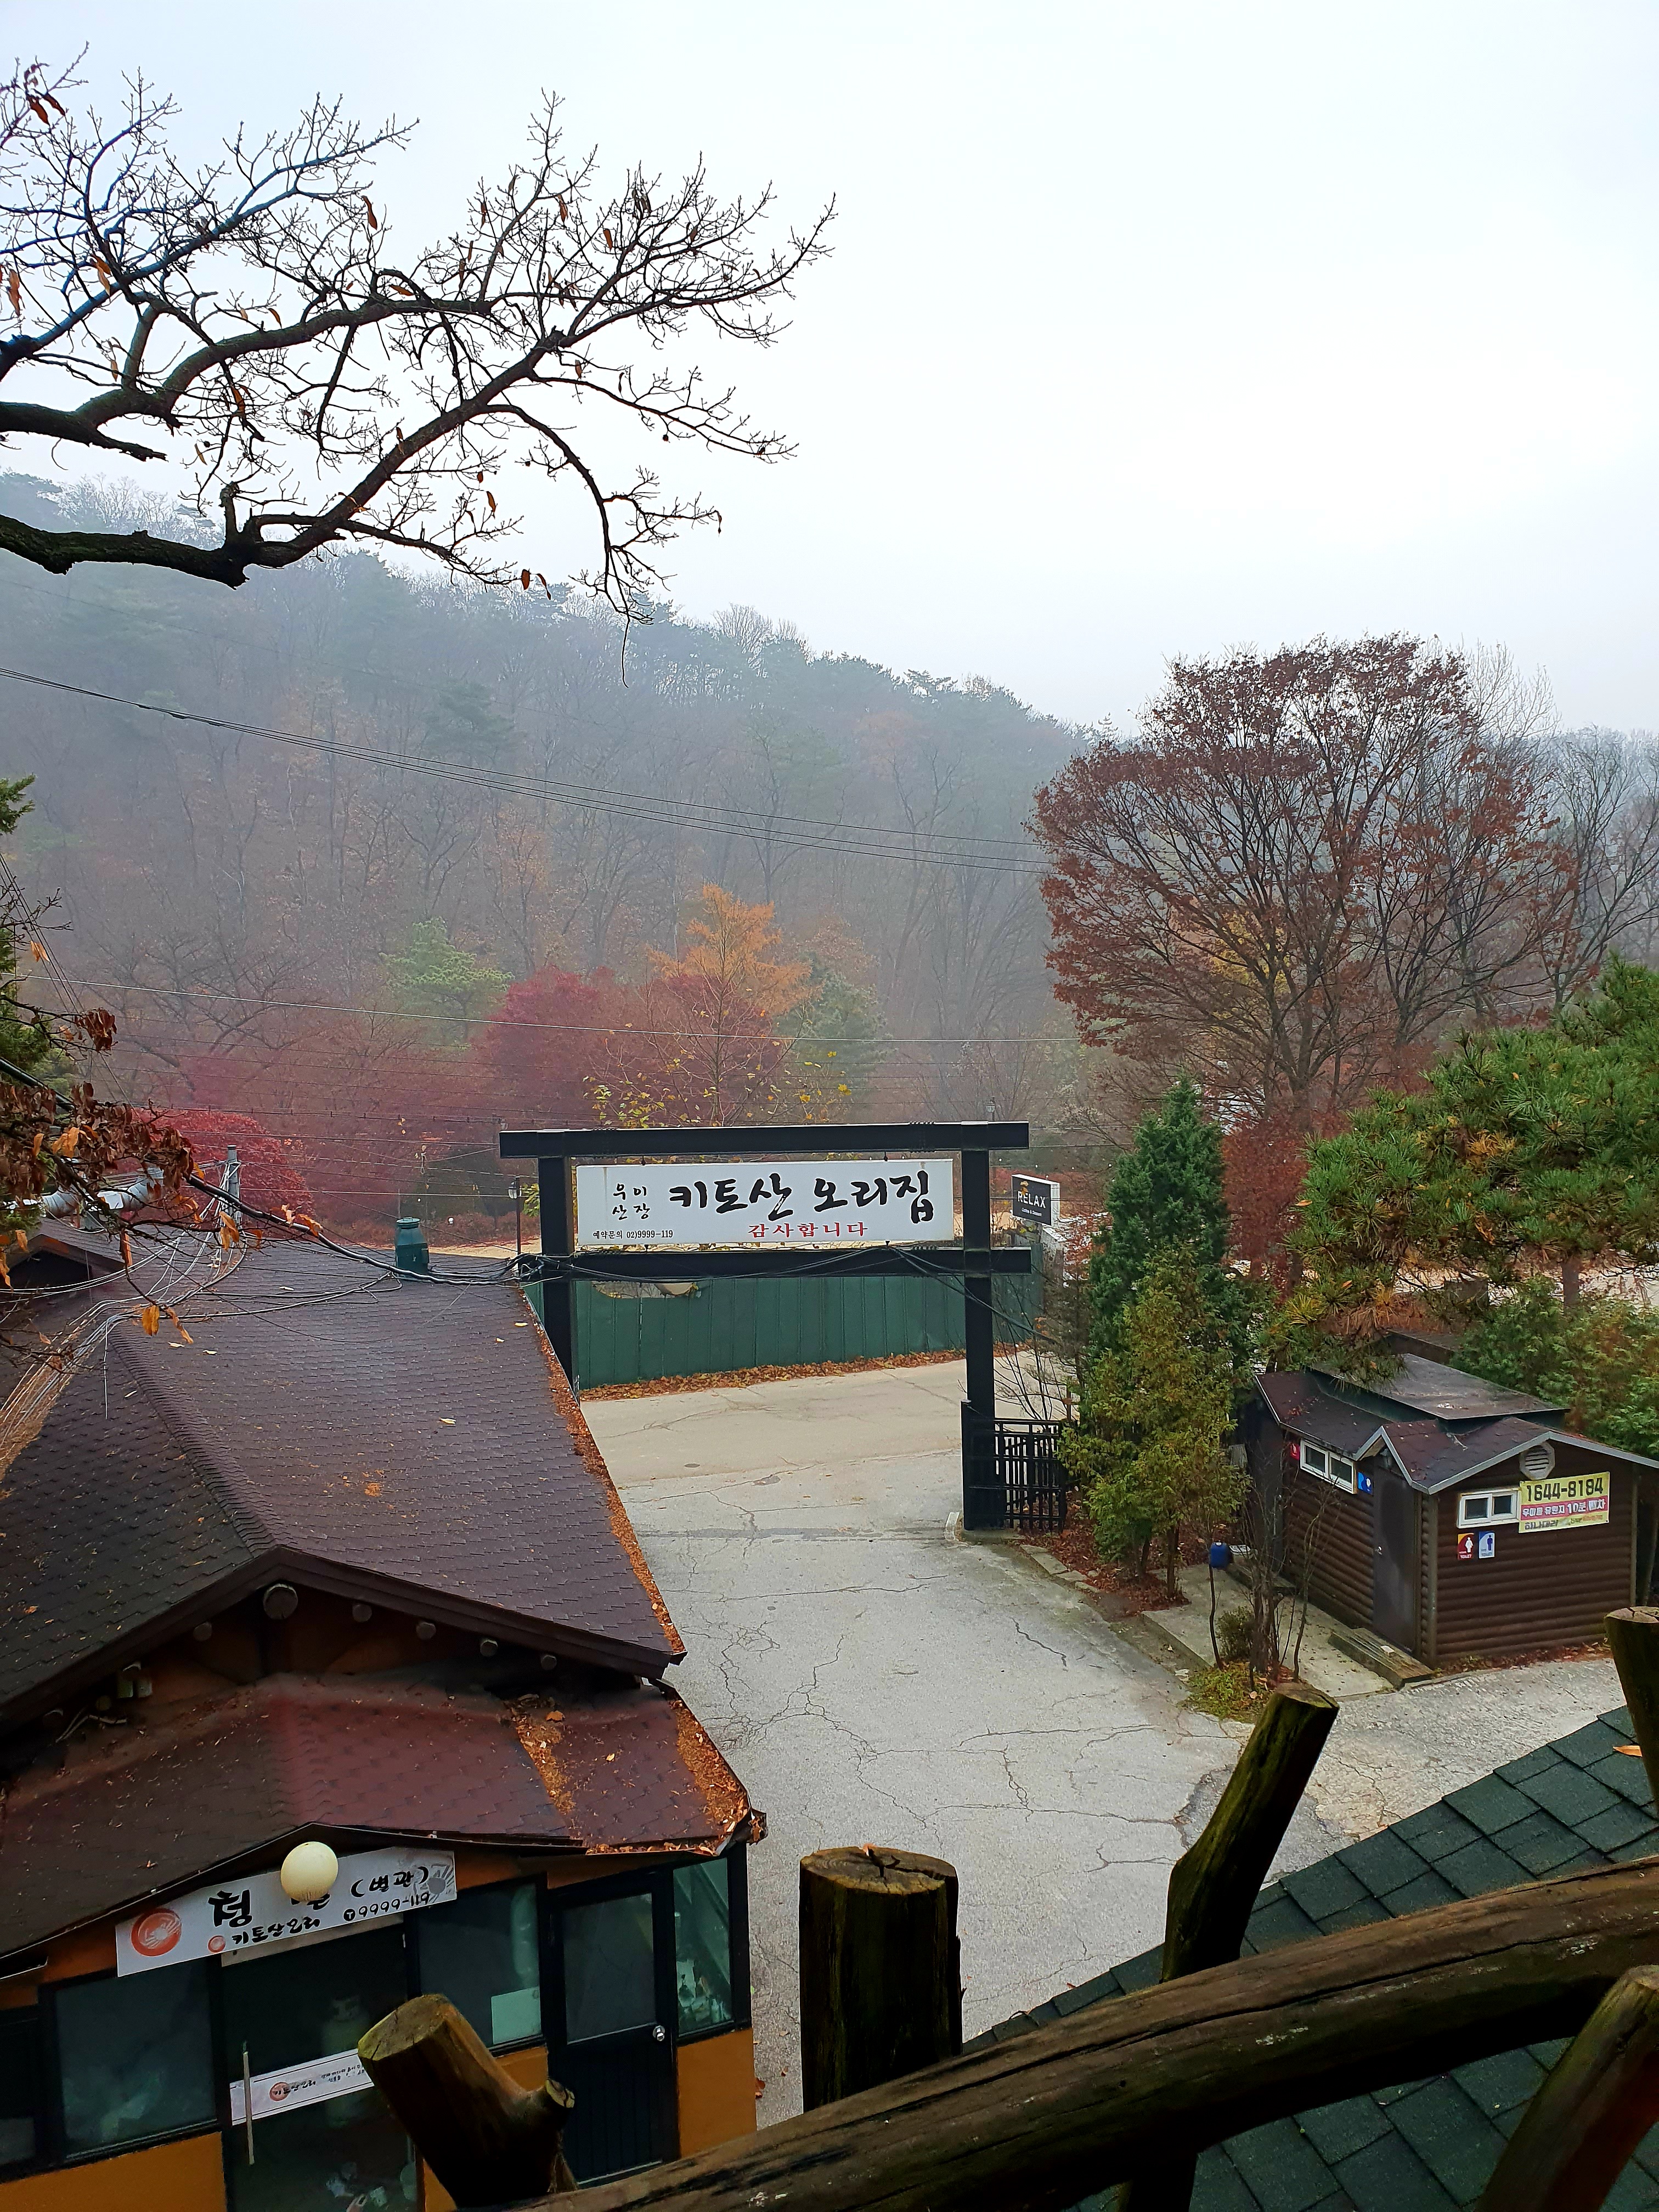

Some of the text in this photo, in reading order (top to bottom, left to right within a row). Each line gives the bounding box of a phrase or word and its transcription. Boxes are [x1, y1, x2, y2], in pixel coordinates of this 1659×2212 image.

[613, 1183, 647, 1200] 우이
[669, 1170, 934, 1224] 키토산 오리집
[1017, 1190, 1046, 1209] RELAX
[612, 1203, 651, 1221] 산장
[592, 1229, 674, 1239] 예약문의 02)9999-119
[748, 1222, 868, 1238] 감사합니다
[1526, 1477, 1603, 1502] 1644-8184
[358, 1891, 430, 1917] 9999-119
